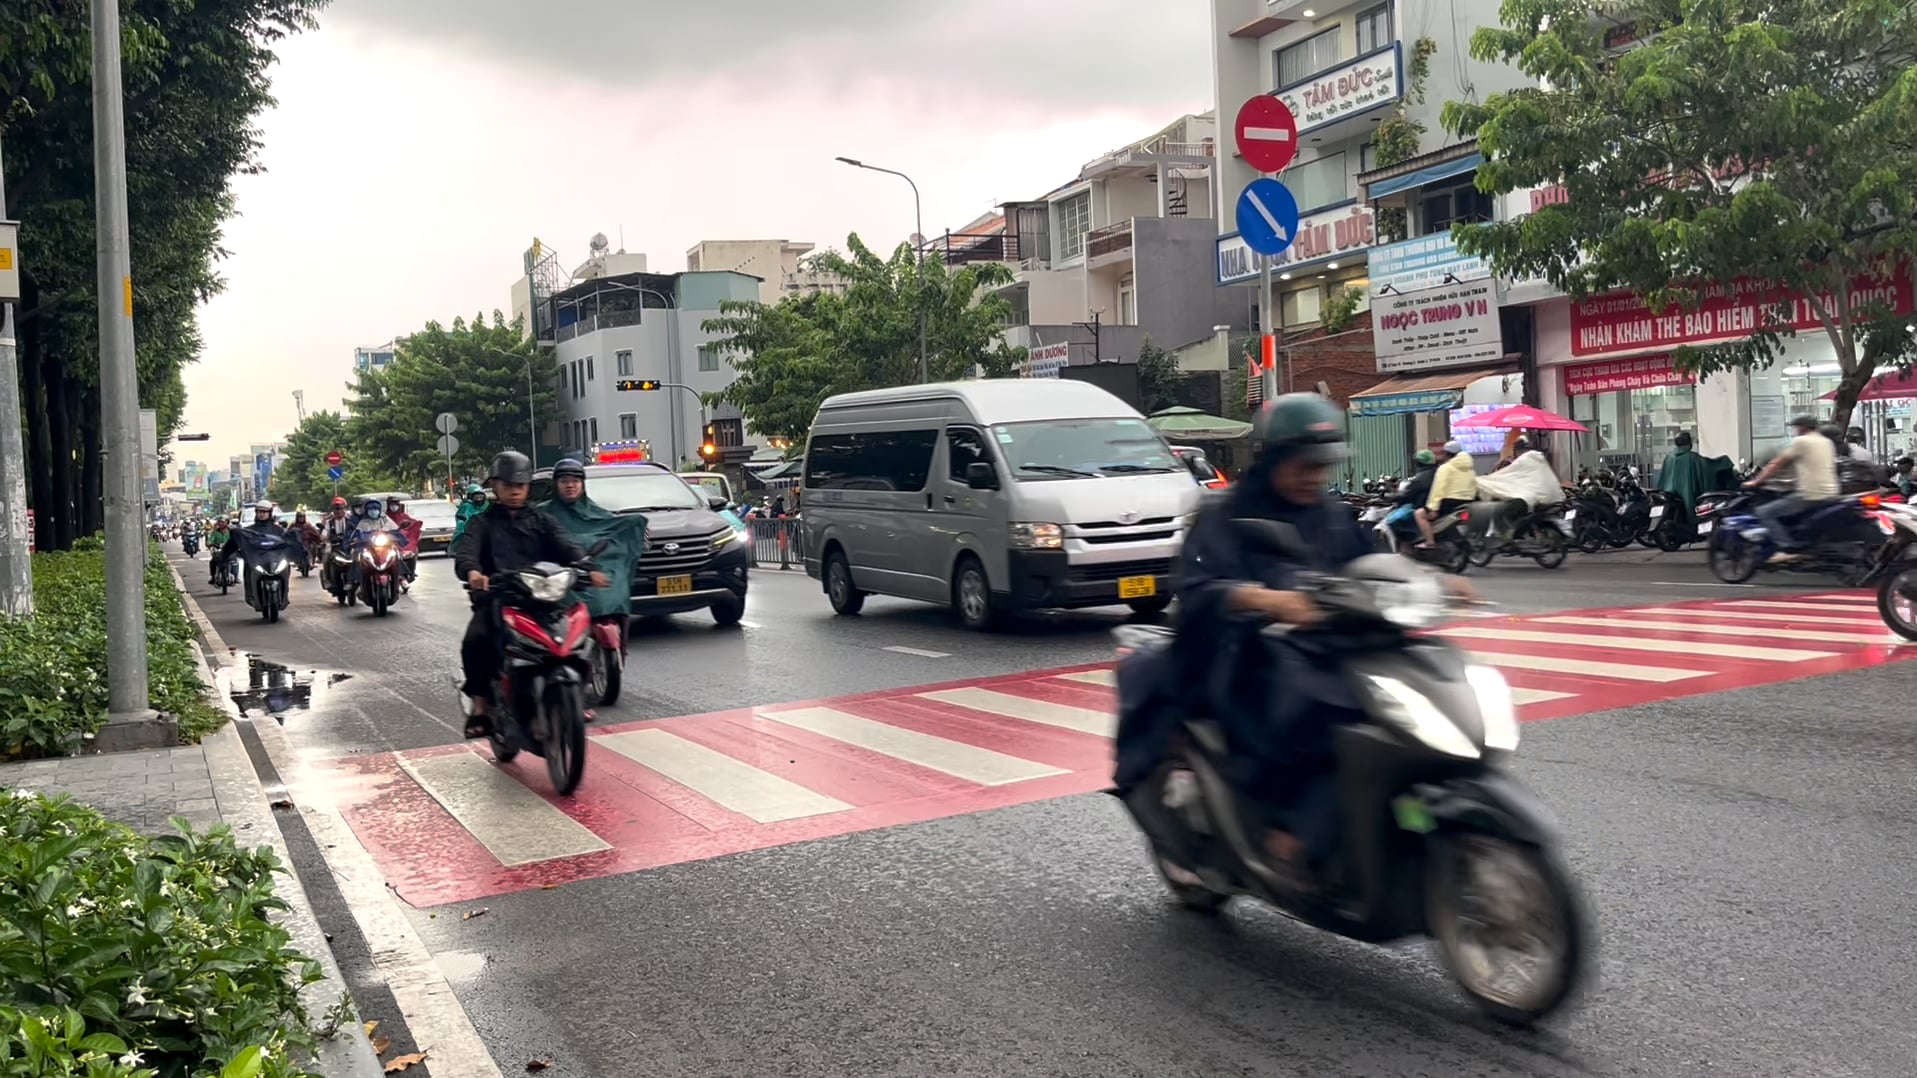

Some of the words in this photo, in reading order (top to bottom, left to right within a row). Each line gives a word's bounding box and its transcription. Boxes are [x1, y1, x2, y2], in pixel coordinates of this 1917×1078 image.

[1302, 82, 1335, 109] TÂM
[1337, 67, 1374, 97] ĐỨC
[1221, 245, 1250, 278] NHA
[1292, 220, 1332, 261] TÂM
[1334, 207, 1374, 250] ĐỨC
[1420, 303, 1462, 324] TRUNG
[1580, 321, 1612, 351] NHẬN
[1616, 315, 1653, 344] KHÁM
[1656, 309, 1681, 339] THẺ
[1685, 308, 1713, 336] BẢO
[1717, 297, 1754, 333] HIỂM
